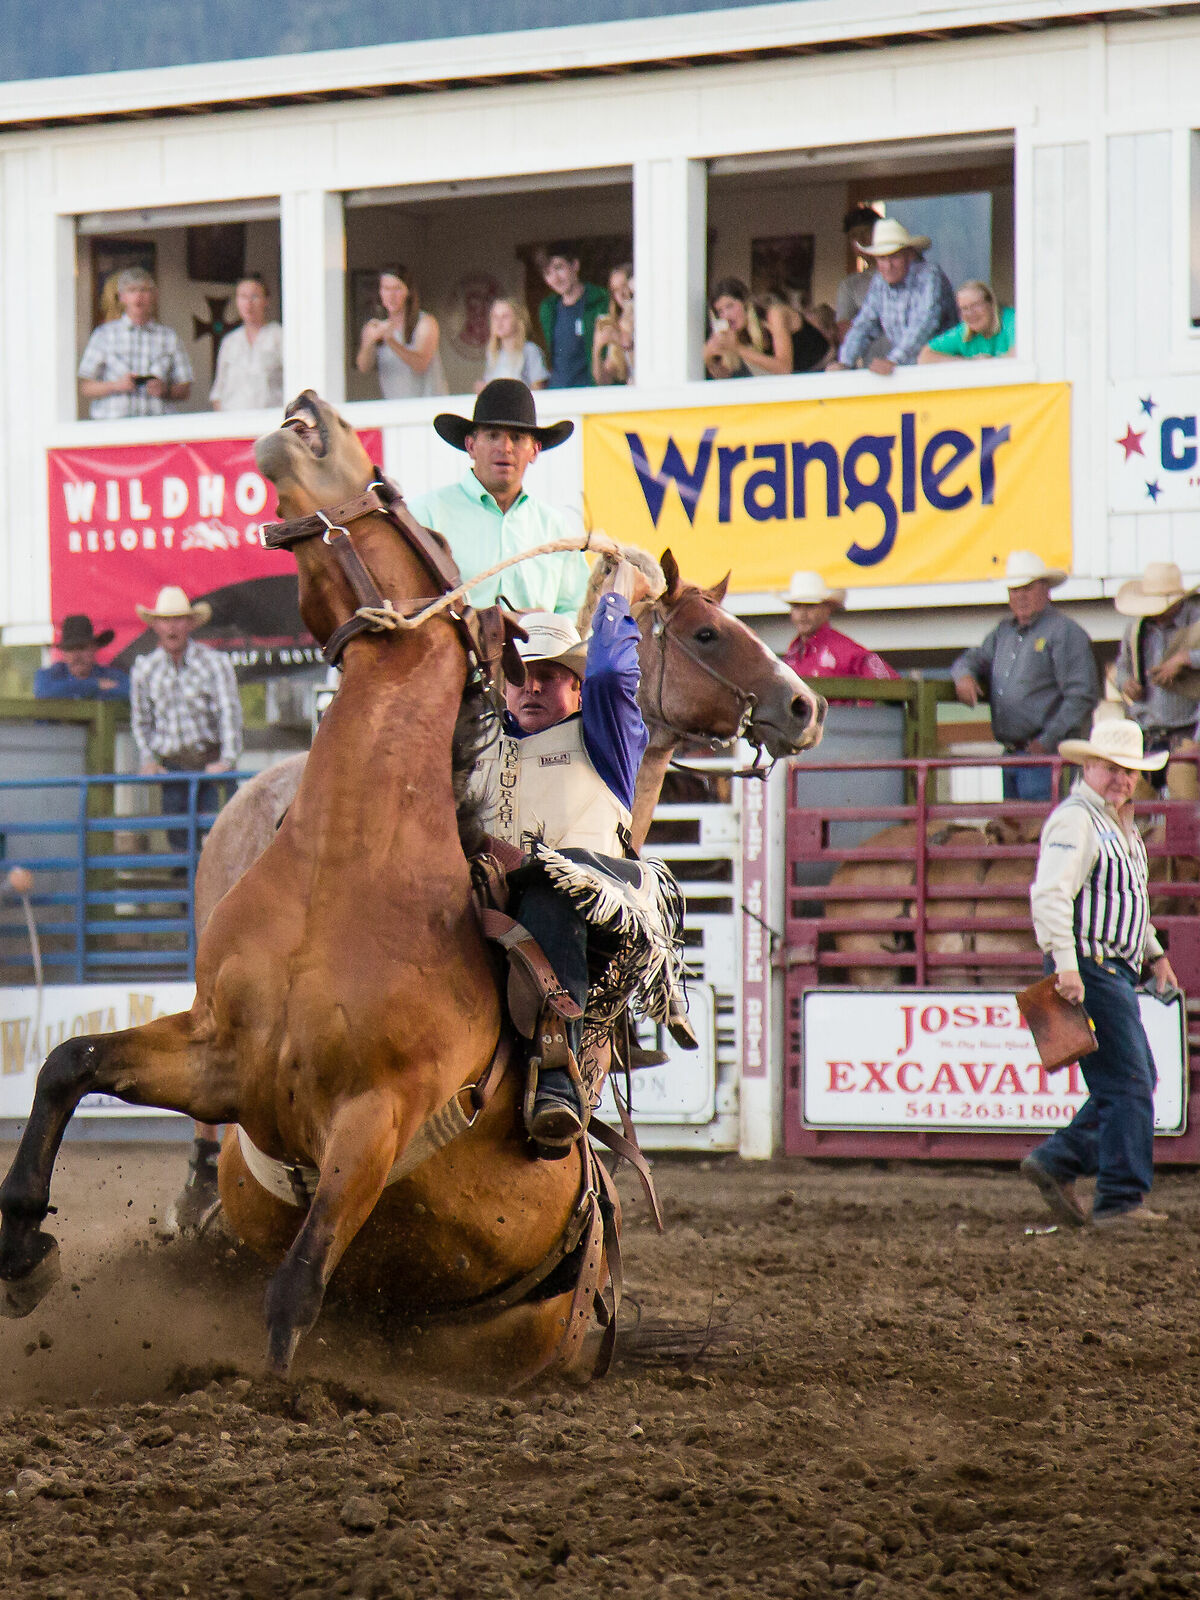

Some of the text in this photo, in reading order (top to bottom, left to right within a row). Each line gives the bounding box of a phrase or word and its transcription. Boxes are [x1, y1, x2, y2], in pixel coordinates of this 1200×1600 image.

[1161, 415, 1200, 471] C
[63, 472, 268, 524] WILDHO
[625, 412, 1011, 566] Wrangler
[68, 527, 174, 553] RESORT
[500, 790, 512, 828] RIGHT
[0, 1007, 116, 1075] WALLOWA
[826, 1061, 1091, 1095] EXCAVATI
[906, 1102, 1077, 1120] 541-263-1800
